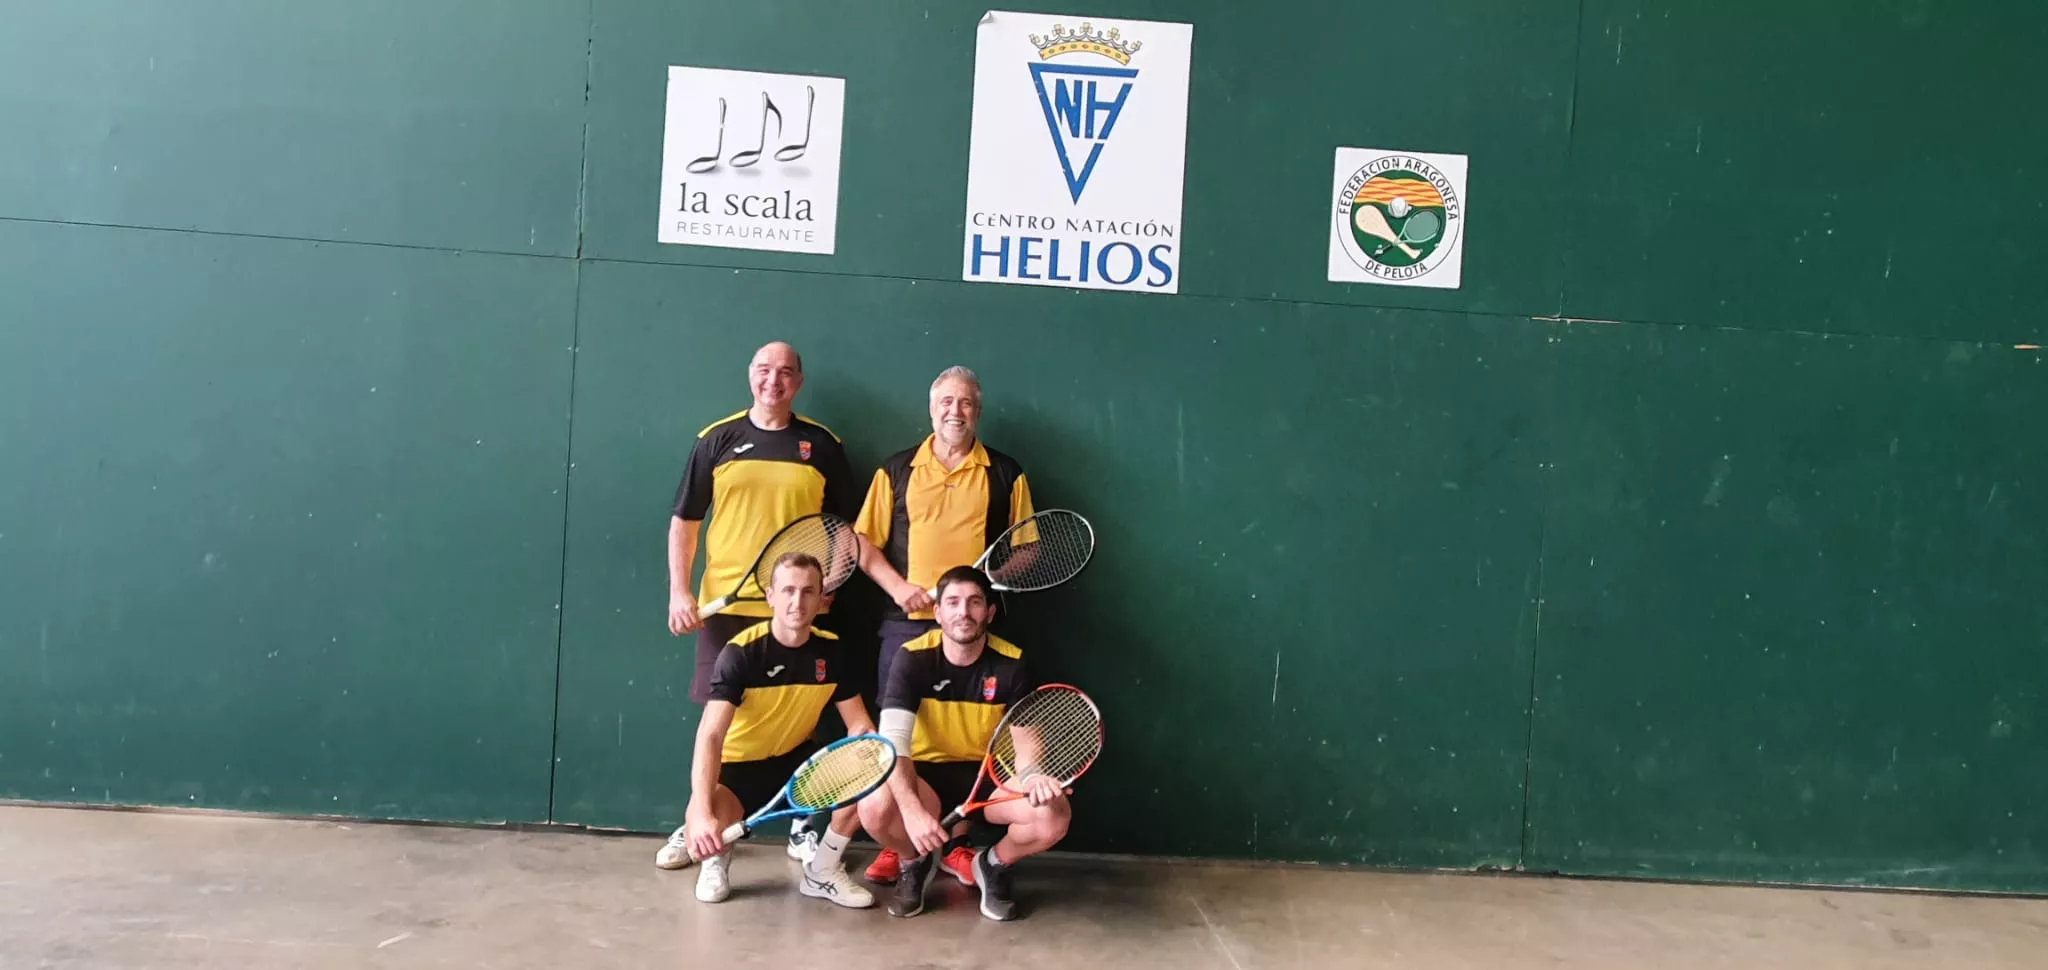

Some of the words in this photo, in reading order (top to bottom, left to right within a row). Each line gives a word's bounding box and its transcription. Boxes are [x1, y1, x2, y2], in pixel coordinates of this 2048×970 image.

[677, 182, 710, 214] la
[723, 190, 815, 222] scala
[1339, 157, 1400, 215] FEDERACION
[1404, 158, 1458, 220] ARAGONESA
[676, 221, 815, 243] RESTAURANTE
[1066, 217, 1175, 238] NATACIÓN
[970, 233, 1173, 288] HELIOS
[1364, 259, 1381, 275] DE
[1383, 262, 1428, 279] PELOTA
